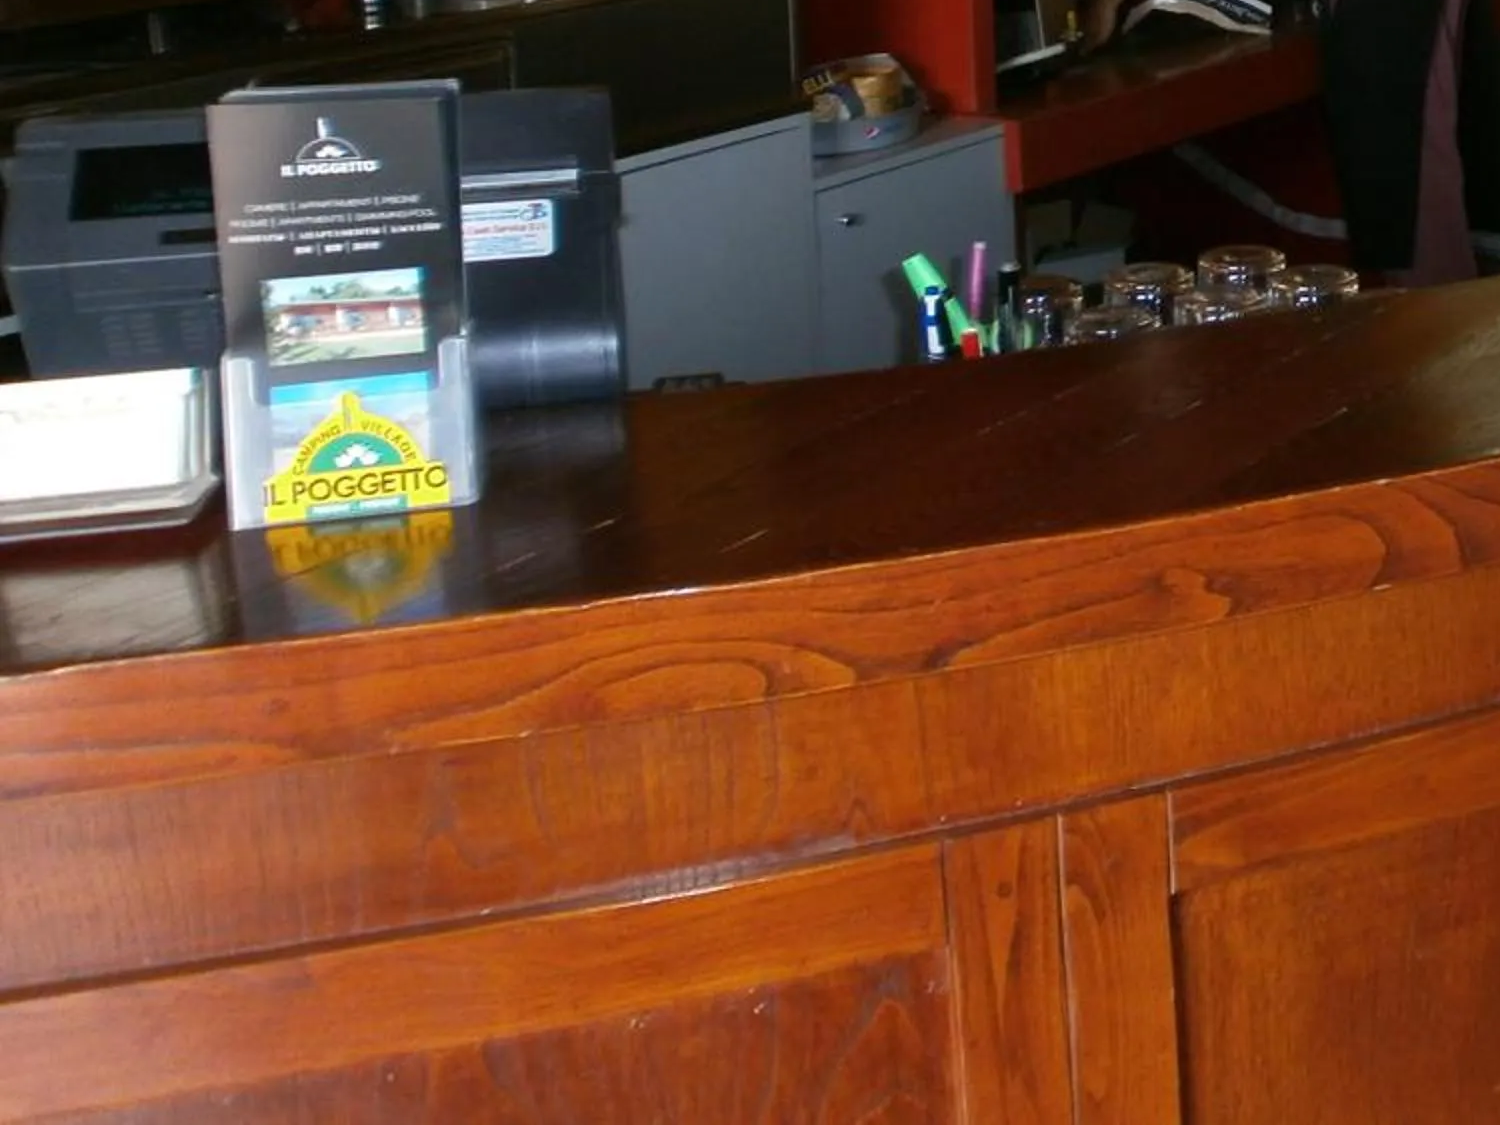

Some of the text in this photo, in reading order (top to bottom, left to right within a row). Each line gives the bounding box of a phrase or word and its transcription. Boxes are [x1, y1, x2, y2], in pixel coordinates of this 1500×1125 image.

[280, 160, 382, 177] IL POGGETTO
[292, 419, 417, 475] CAMPING VILLAGE
[263, 483, 287, 507] IL
[291, 465, 448, 505] POGGETTO
